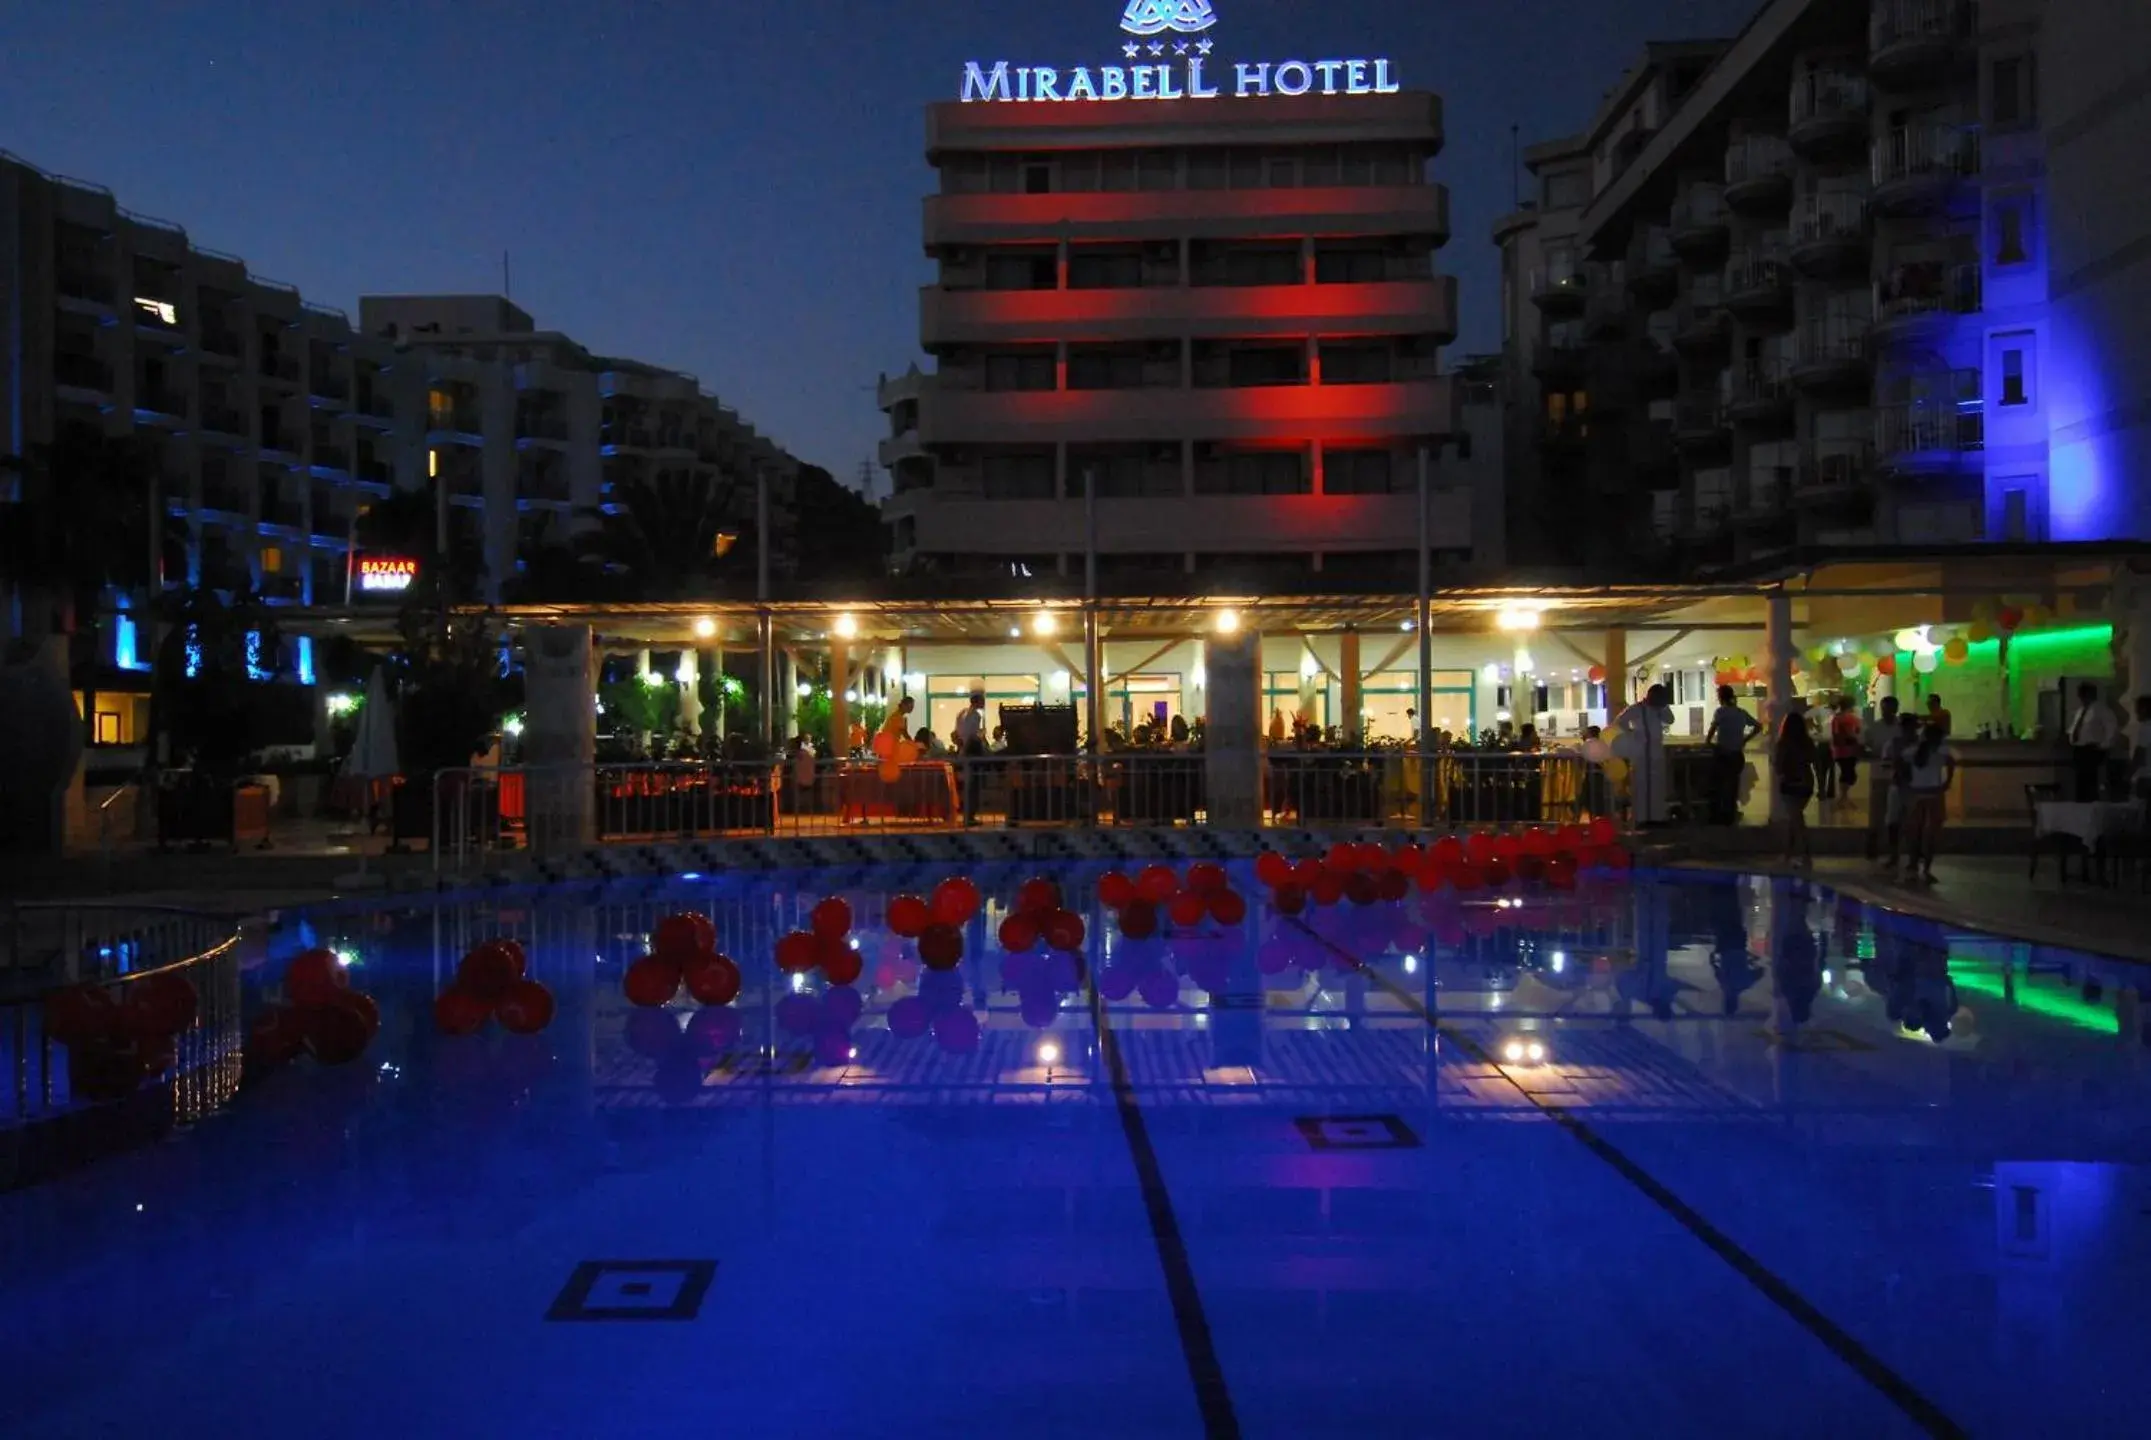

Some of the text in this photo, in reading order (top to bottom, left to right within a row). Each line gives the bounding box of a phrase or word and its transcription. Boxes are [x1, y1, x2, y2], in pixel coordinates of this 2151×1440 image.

[961, 58, 1399, 102] MIRABELL HOTEL
[361, 560, 416, 574] BAZAAR
